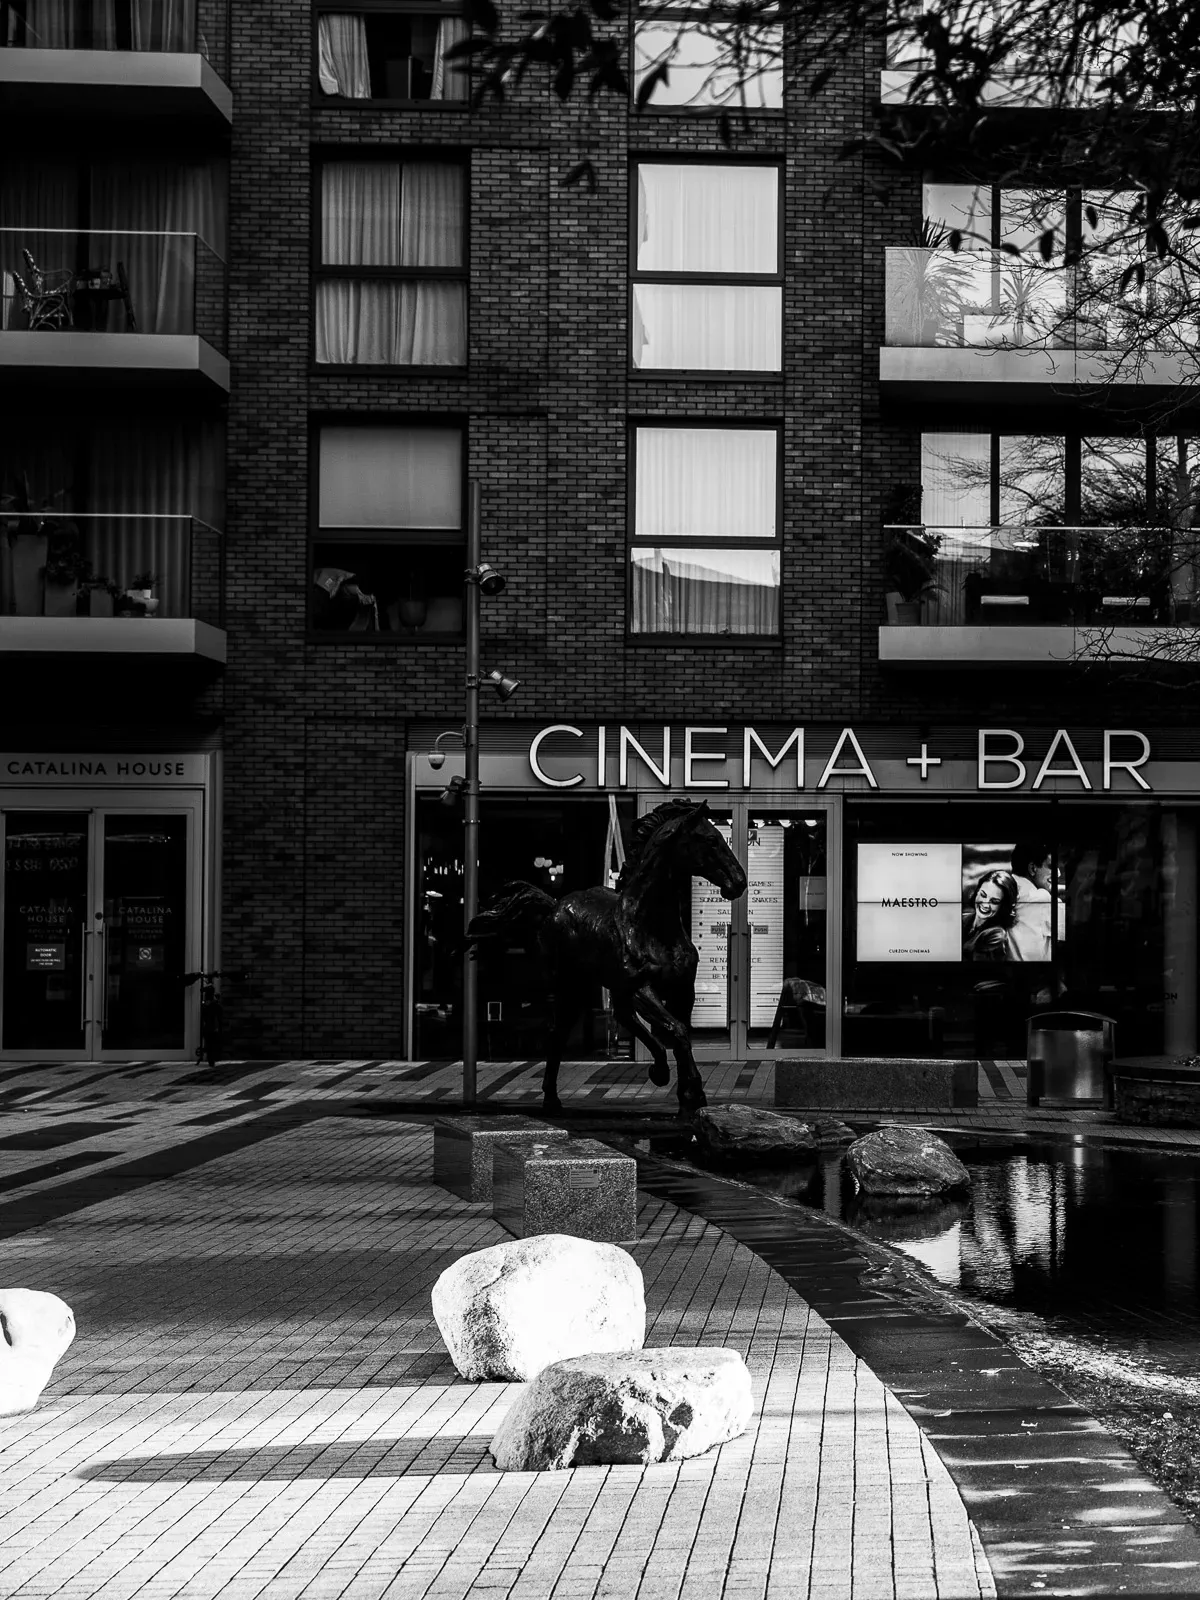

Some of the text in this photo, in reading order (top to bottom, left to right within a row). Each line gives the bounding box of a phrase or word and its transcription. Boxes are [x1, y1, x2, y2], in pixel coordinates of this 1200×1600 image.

[529, 724, 880, 788] CINEMA
[977, 728, 1153, 790] BAR
[7, 761, 184, 776] CATALINA HOUSE
[881, 897, 939, 908] MAESTRO
[19, 905, 73, 915] CATALINA
[118, 906, 172, 915] CATALINA
[27, 915, 66, 924] HOUSE
[126, 915, 165, 924] HOUSE
